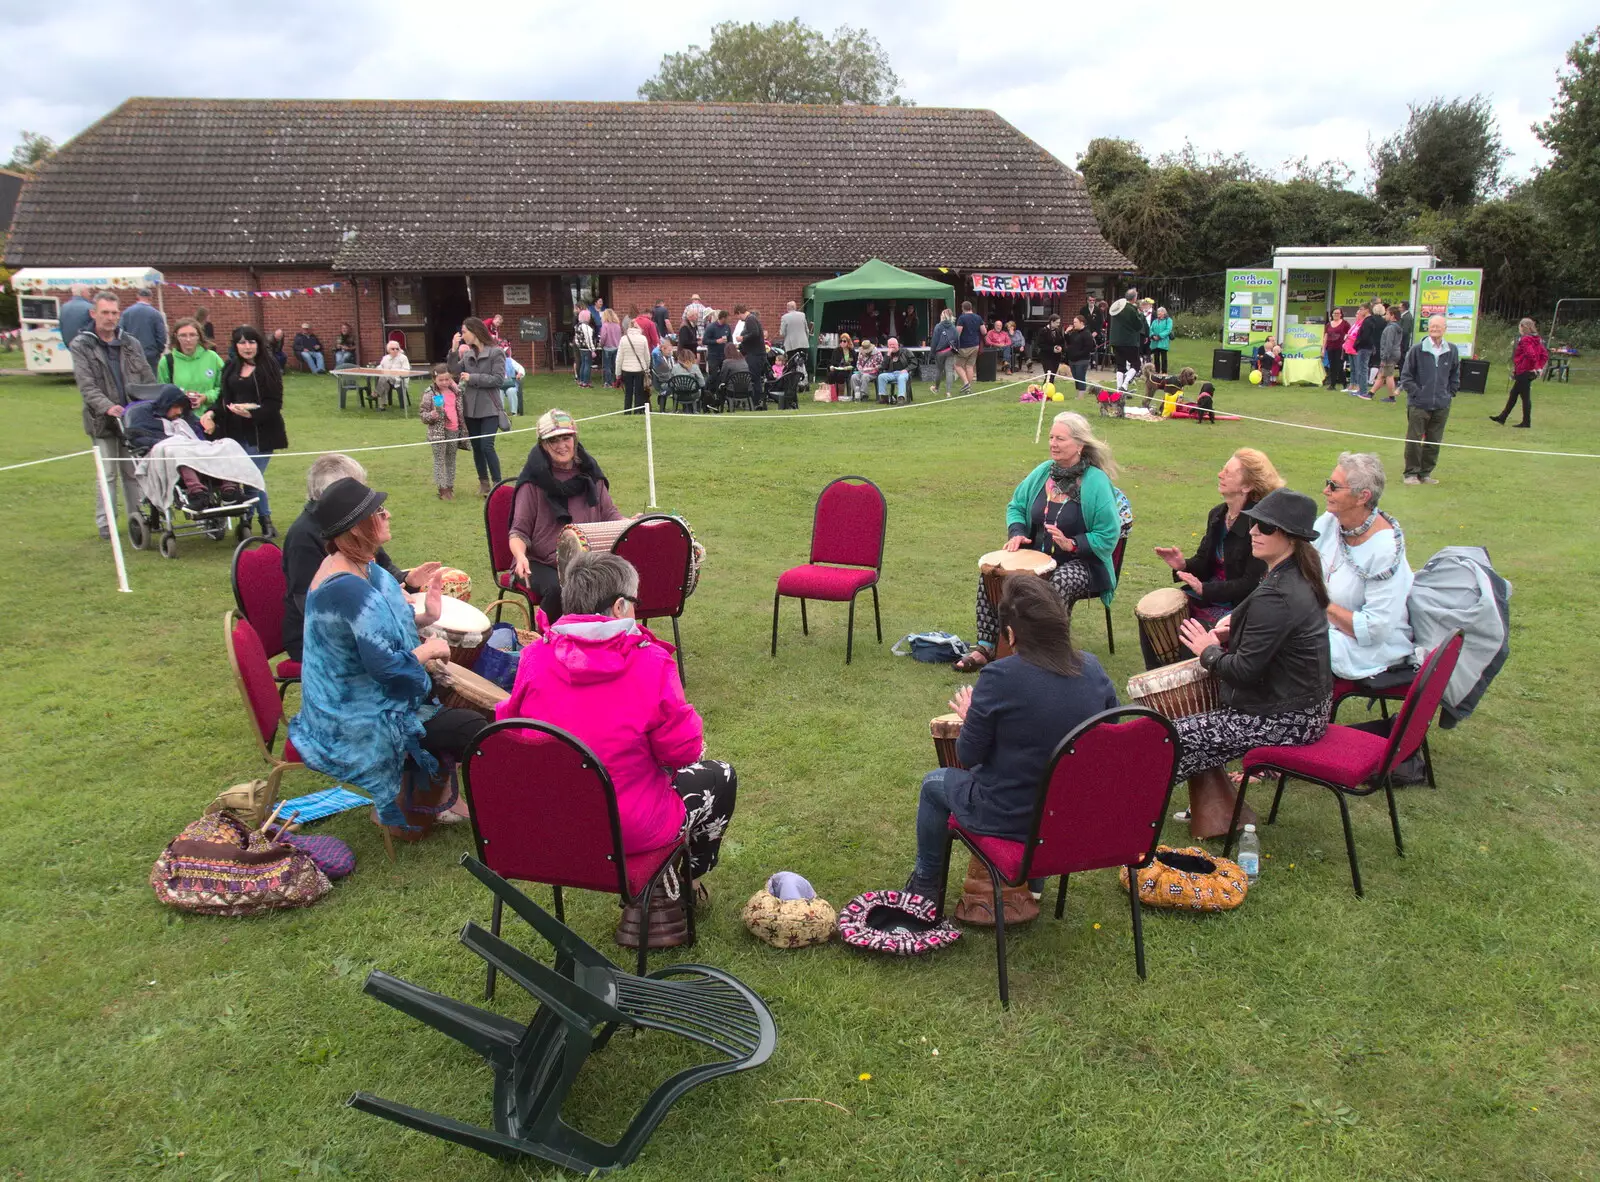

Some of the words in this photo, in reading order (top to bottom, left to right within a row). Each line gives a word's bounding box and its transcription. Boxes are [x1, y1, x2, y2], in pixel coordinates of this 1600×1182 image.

[1233, 274, 1256, 282] park
[1427, 274, 1453, 282] park
[1443, 278, 1474, 286] radio
[973, 274, 1067, 291] REFRESHMENTS
